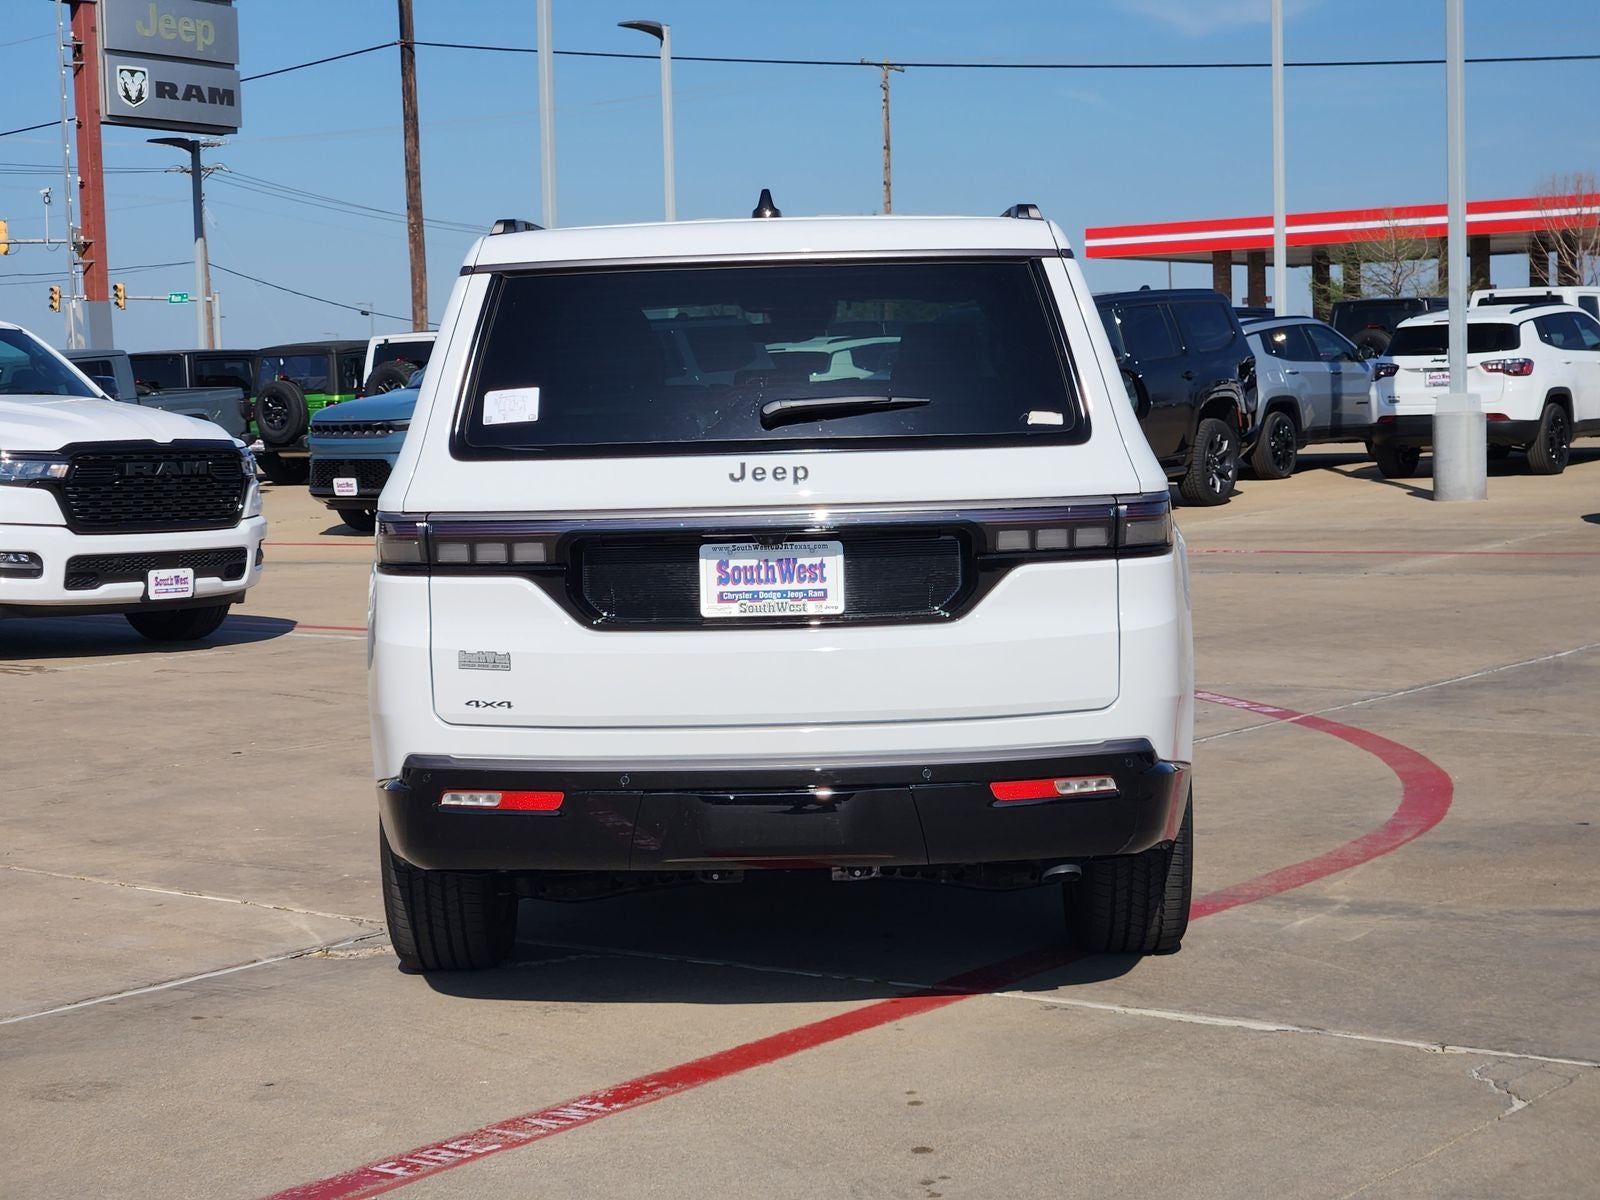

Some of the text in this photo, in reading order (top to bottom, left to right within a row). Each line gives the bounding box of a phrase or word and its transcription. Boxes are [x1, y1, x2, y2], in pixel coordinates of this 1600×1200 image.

[135, 2, 216, 51] Jeep
[155, 80, 235, 107] RAM
[125, 461, 208, 476] RAM
[728, 462, 809, 485] Jeep
[716, 557, 827, 586] SouthWest
[722, 589, 824, 600] Chrysler Dodge Jeep Ram
[739, 602, 808, 613] SouthWest
[464, 699, 514, 709] 4x4
